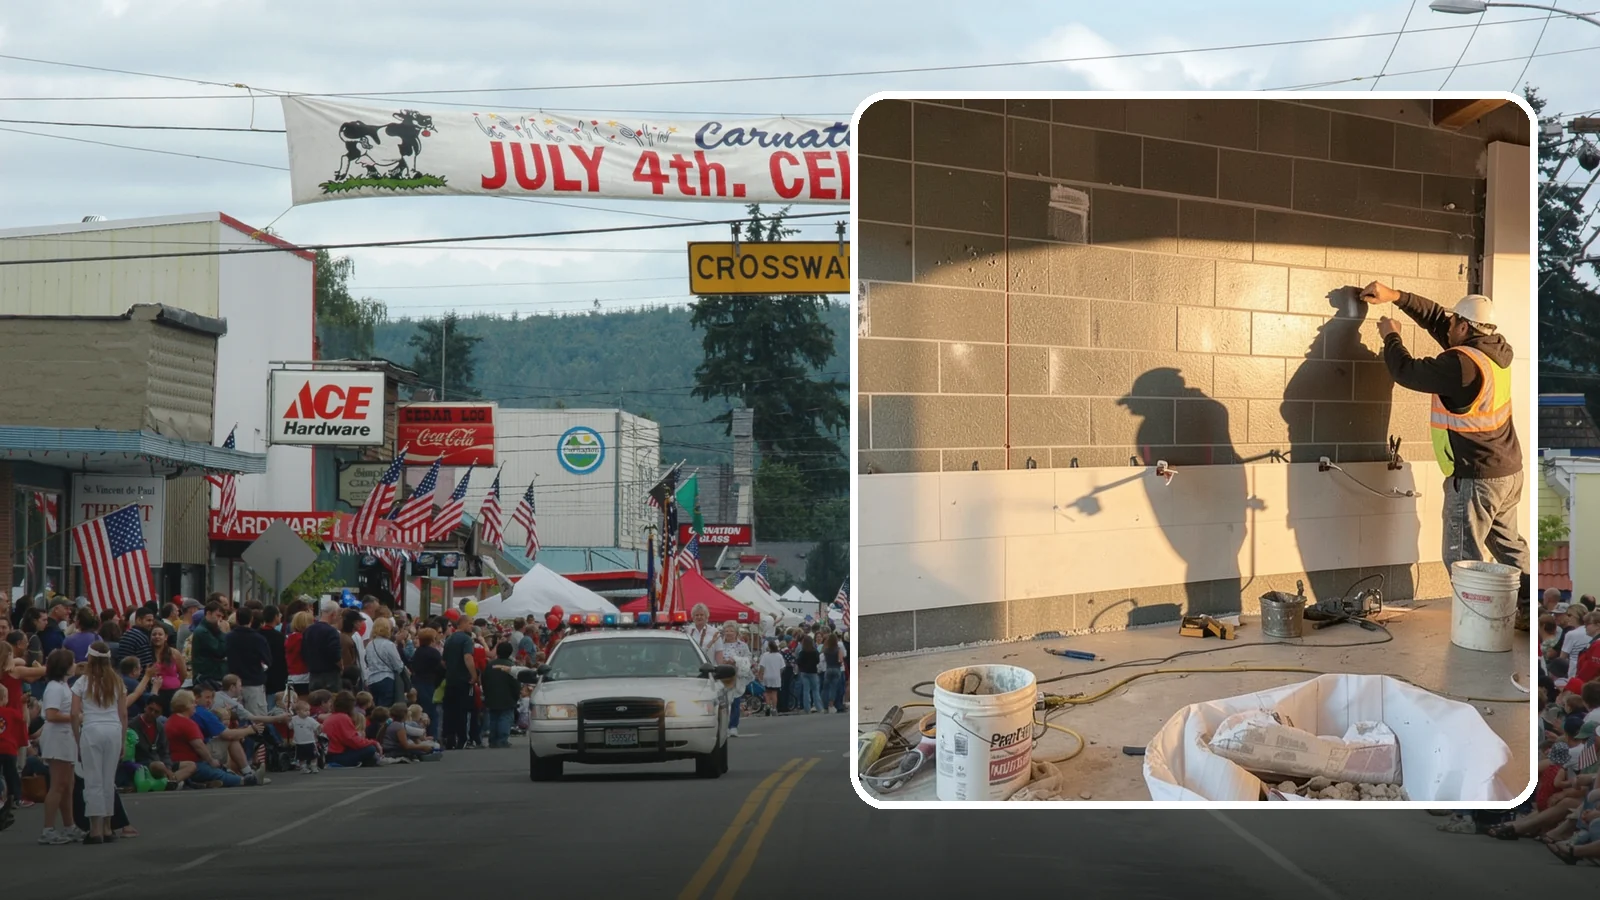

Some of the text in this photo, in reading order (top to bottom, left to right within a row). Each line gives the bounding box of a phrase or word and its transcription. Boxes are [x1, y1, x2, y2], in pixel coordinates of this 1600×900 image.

[481, 141, 604, 193] JULY
[633, 149, 746, 197] 4th.
[697, 254, 850, 280] CROSSWA
[283, 380, 373, 419] ACE
[406, 409, 485, 422] CEDAR LOG
[284, 421, 371, 436] Hardware
[416, 428, 477, 446] Coca-Cola
[96, 485, 124, 494] Vincent
[126, 486, 135, 494] de
[137, 486, 155, 495] Paul
[213, 516, 330, 535] HARDARE
[688, 526, 741, 535] CRNATION
[699, 535, 730, 543] GLASS
